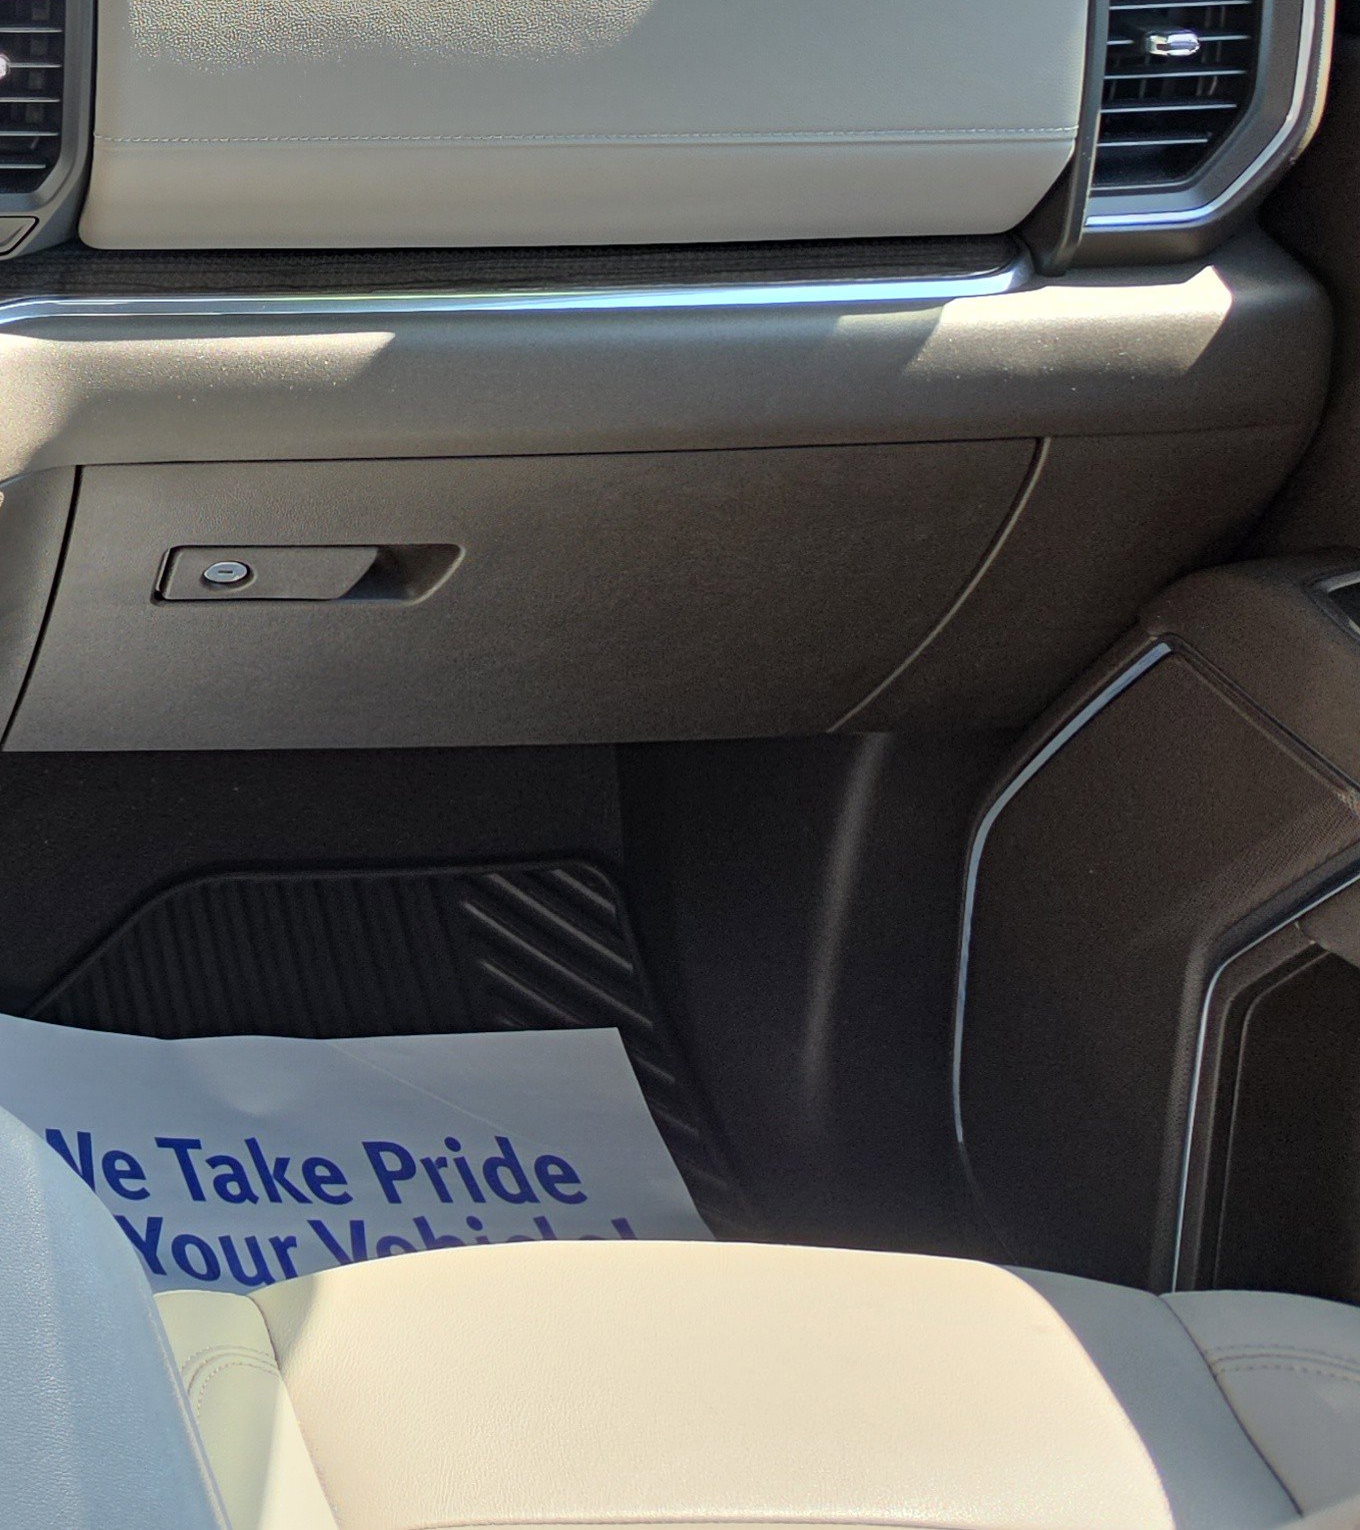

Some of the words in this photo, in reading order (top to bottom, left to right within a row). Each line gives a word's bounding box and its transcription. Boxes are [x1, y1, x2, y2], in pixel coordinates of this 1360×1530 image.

[154, 1136, 354, 1205] Take
[361, 1136, 588, 1205] Pride
[113, 1215, 298, 1288] Your
